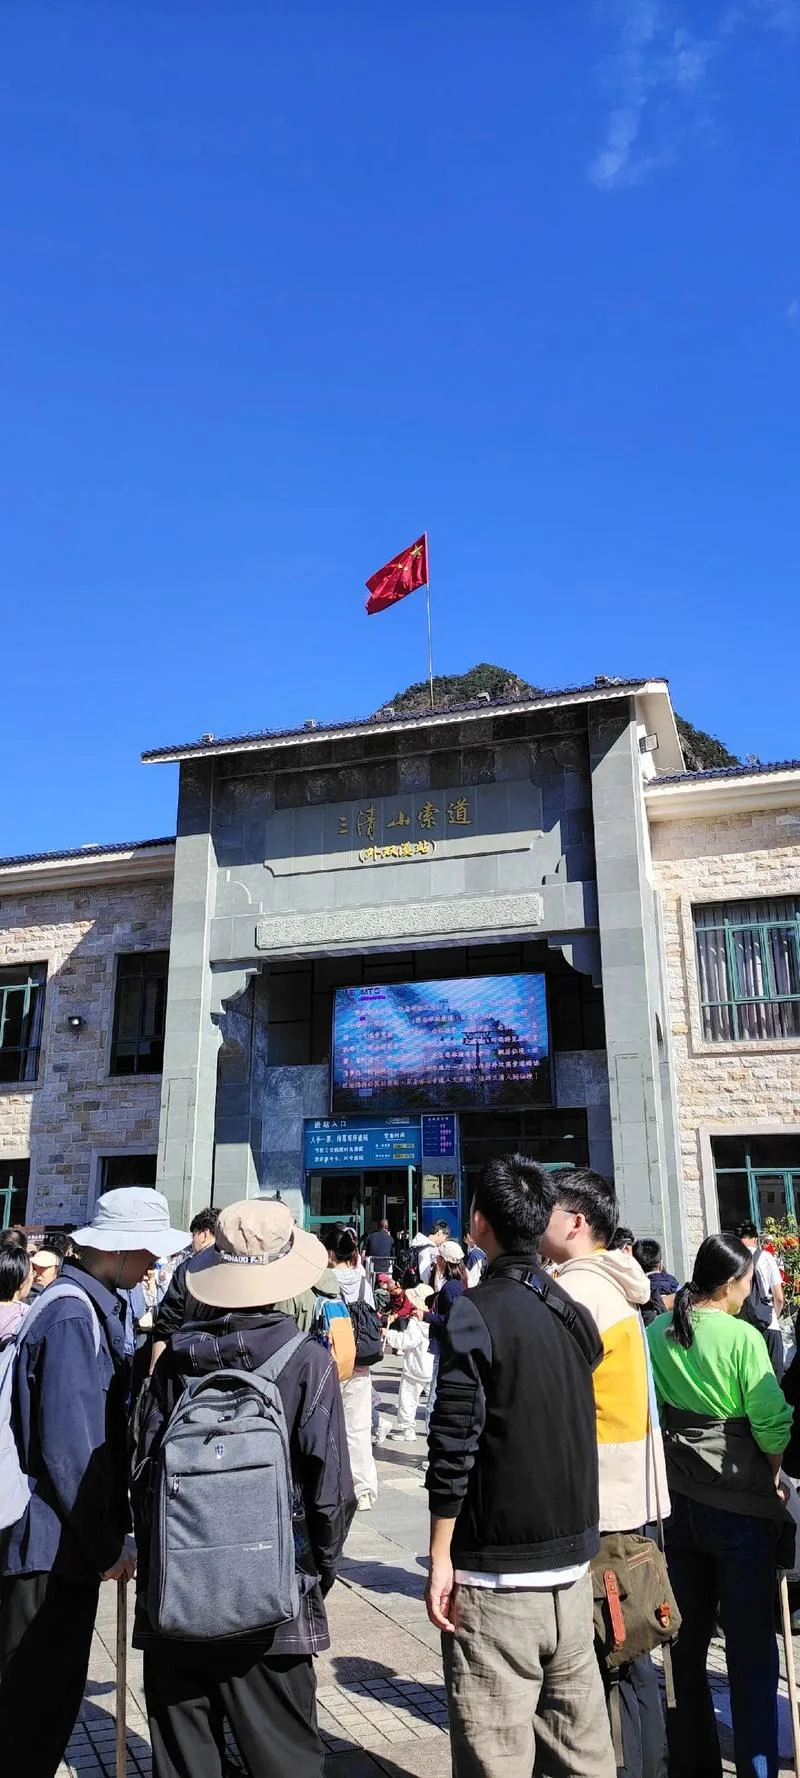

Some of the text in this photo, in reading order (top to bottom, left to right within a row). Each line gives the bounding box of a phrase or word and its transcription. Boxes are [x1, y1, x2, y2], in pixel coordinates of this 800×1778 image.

[337, 797, 472, 841] 三清山索道
[313, 1120, 347, 1129] 进站入口
